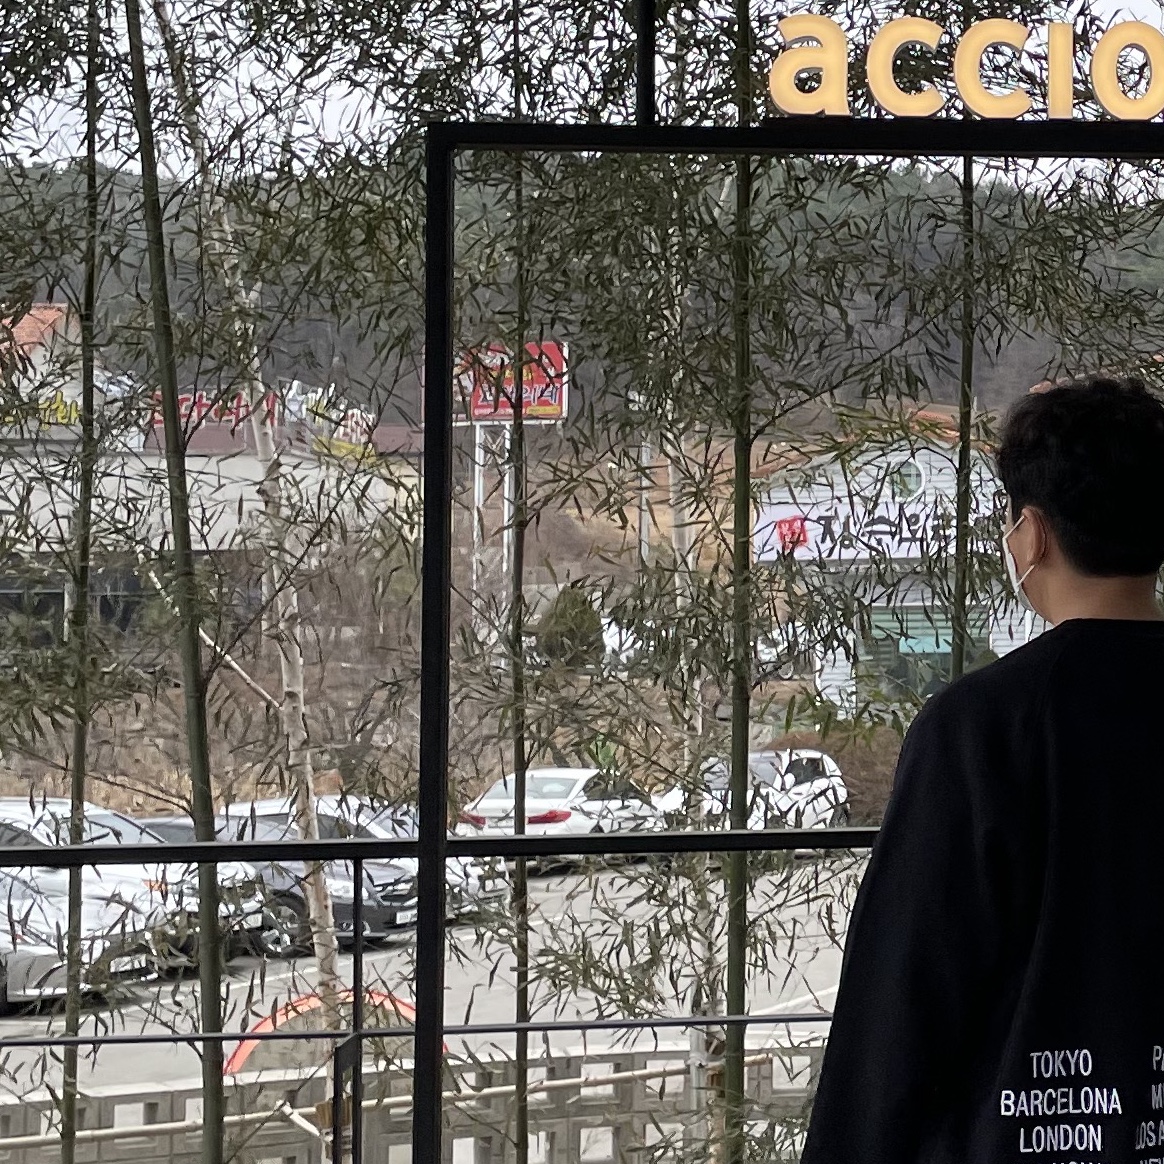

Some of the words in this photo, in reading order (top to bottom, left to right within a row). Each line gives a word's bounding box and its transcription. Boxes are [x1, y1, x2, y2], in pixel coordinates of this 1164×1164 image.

[1029, 1048, 1093, 1078] TOKYO
[1000, 1086, 1123, 1117] BARCELONA
[1019, 1123, 1102, 1153] LONDON
